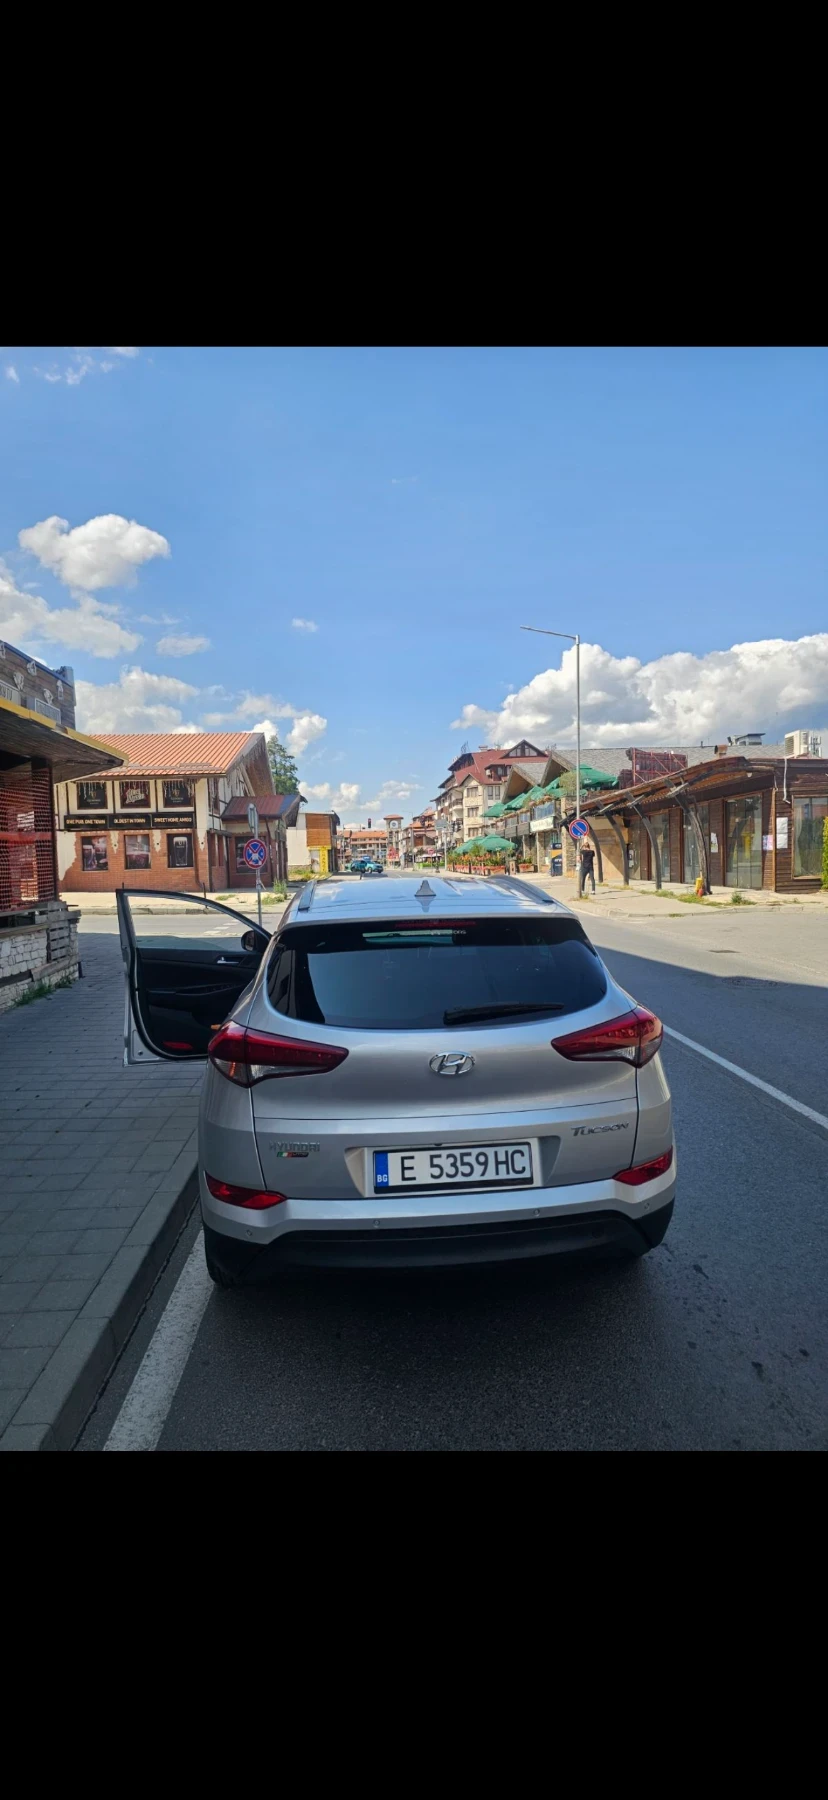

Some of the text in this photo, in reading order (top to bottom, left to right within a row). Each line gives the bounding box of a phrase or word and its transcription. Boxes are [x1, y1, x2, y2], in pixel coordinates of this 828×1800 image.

[570, 1121, 630, 1137] TUCSON
[268, 1141, 321, 1152] HYUNDAI
[400, 1149, 527, 1182] E 5359 HC
[376, 1174, 389, 1184] BG
